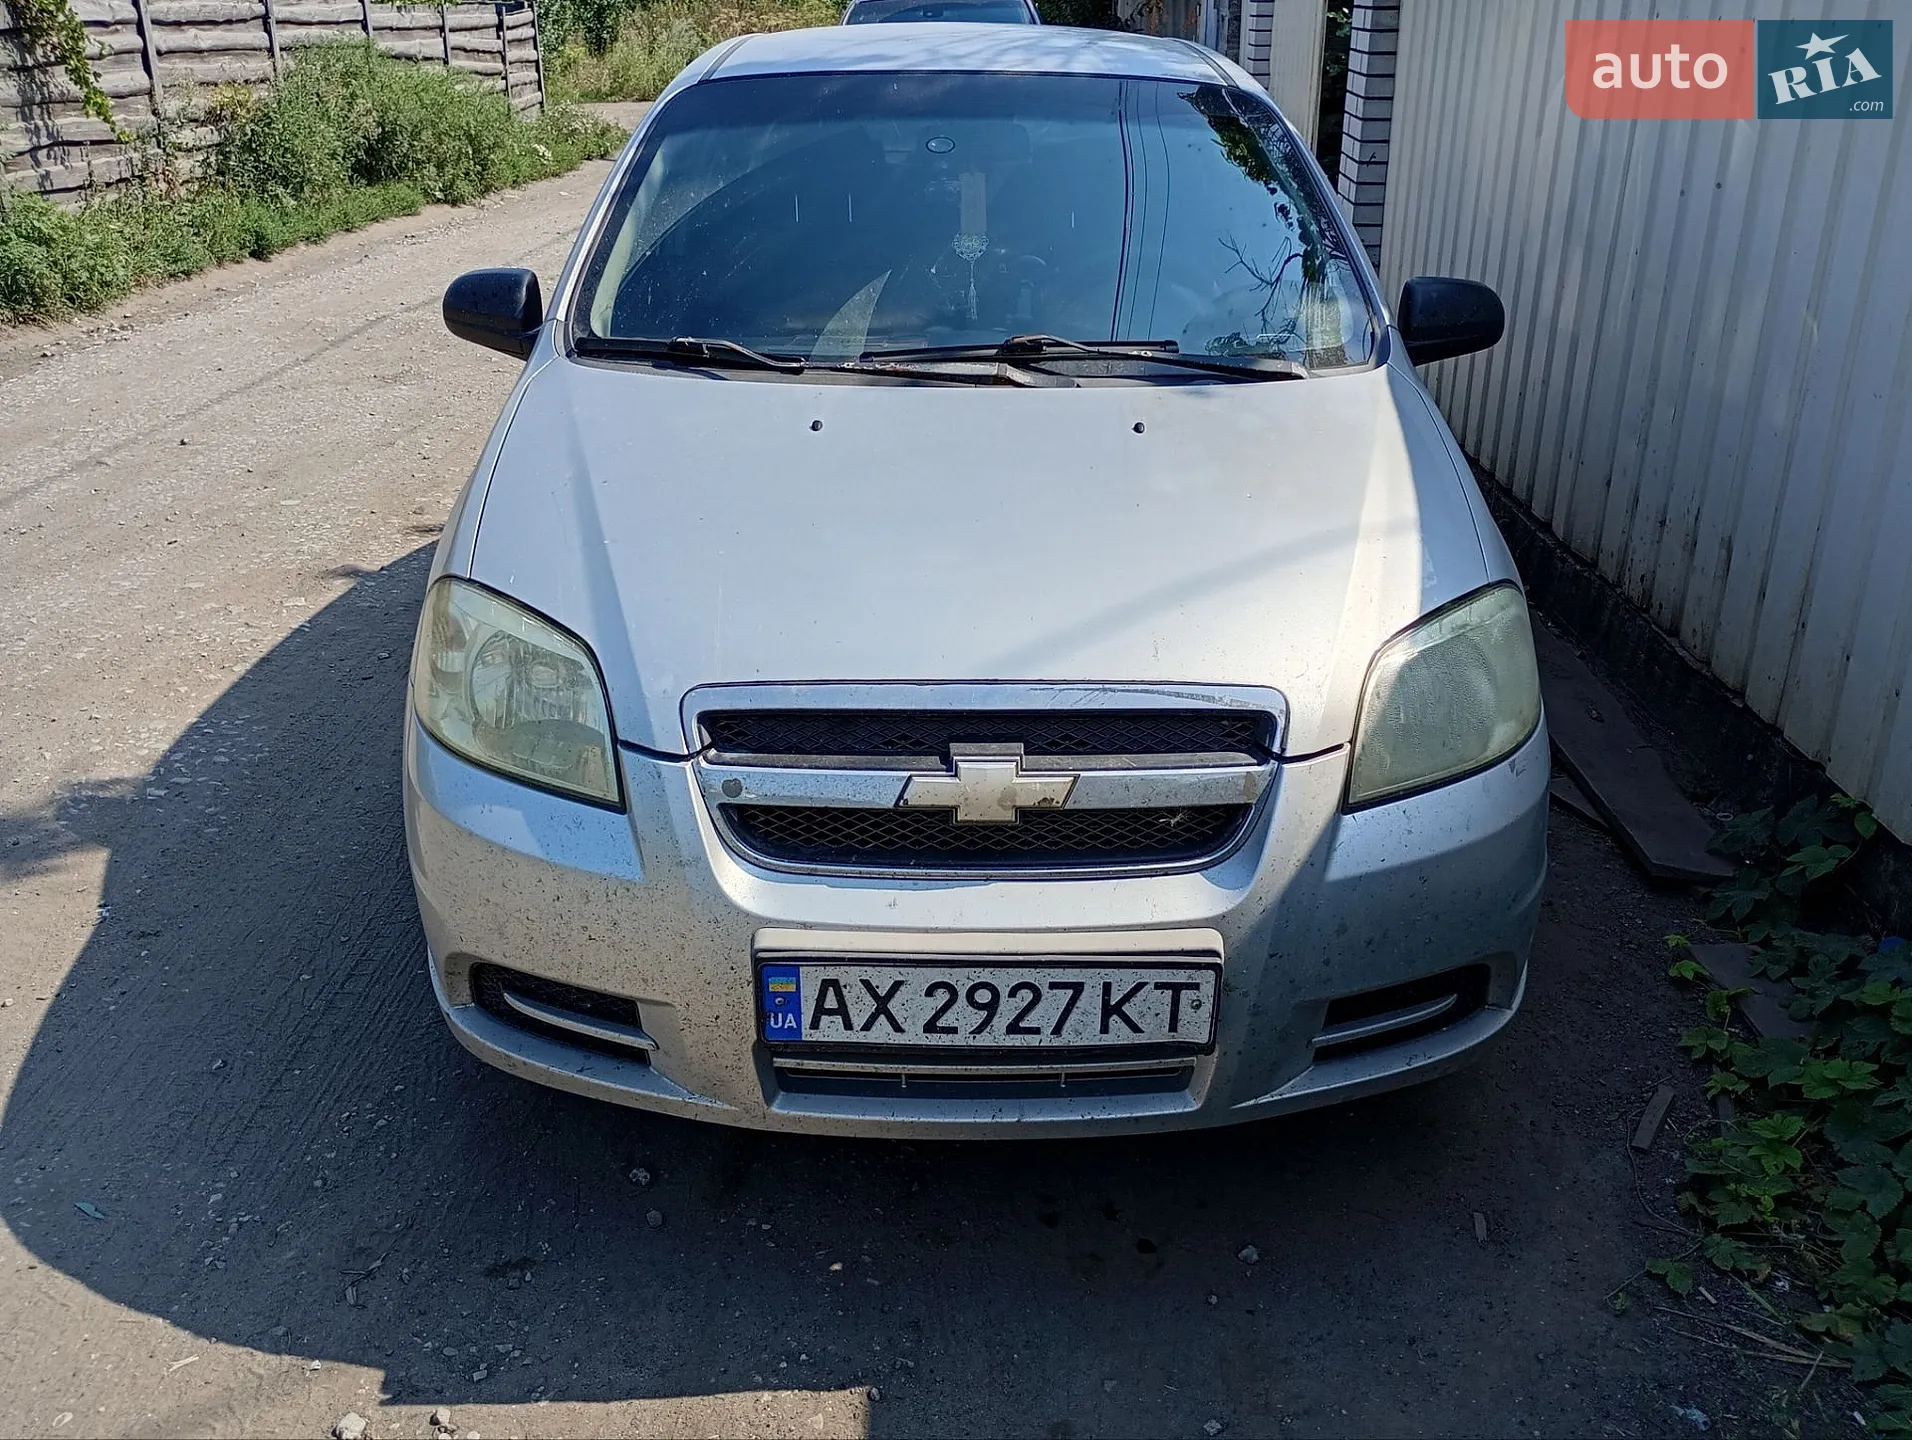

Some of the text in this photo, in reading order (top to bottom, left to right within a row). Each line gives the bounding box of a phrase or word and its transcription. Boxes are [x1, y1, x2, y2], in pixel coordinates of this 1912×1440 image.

[770, 1012, 798, 1030] UA
[808, 978, 1200, 1036] AX 2927 KT
